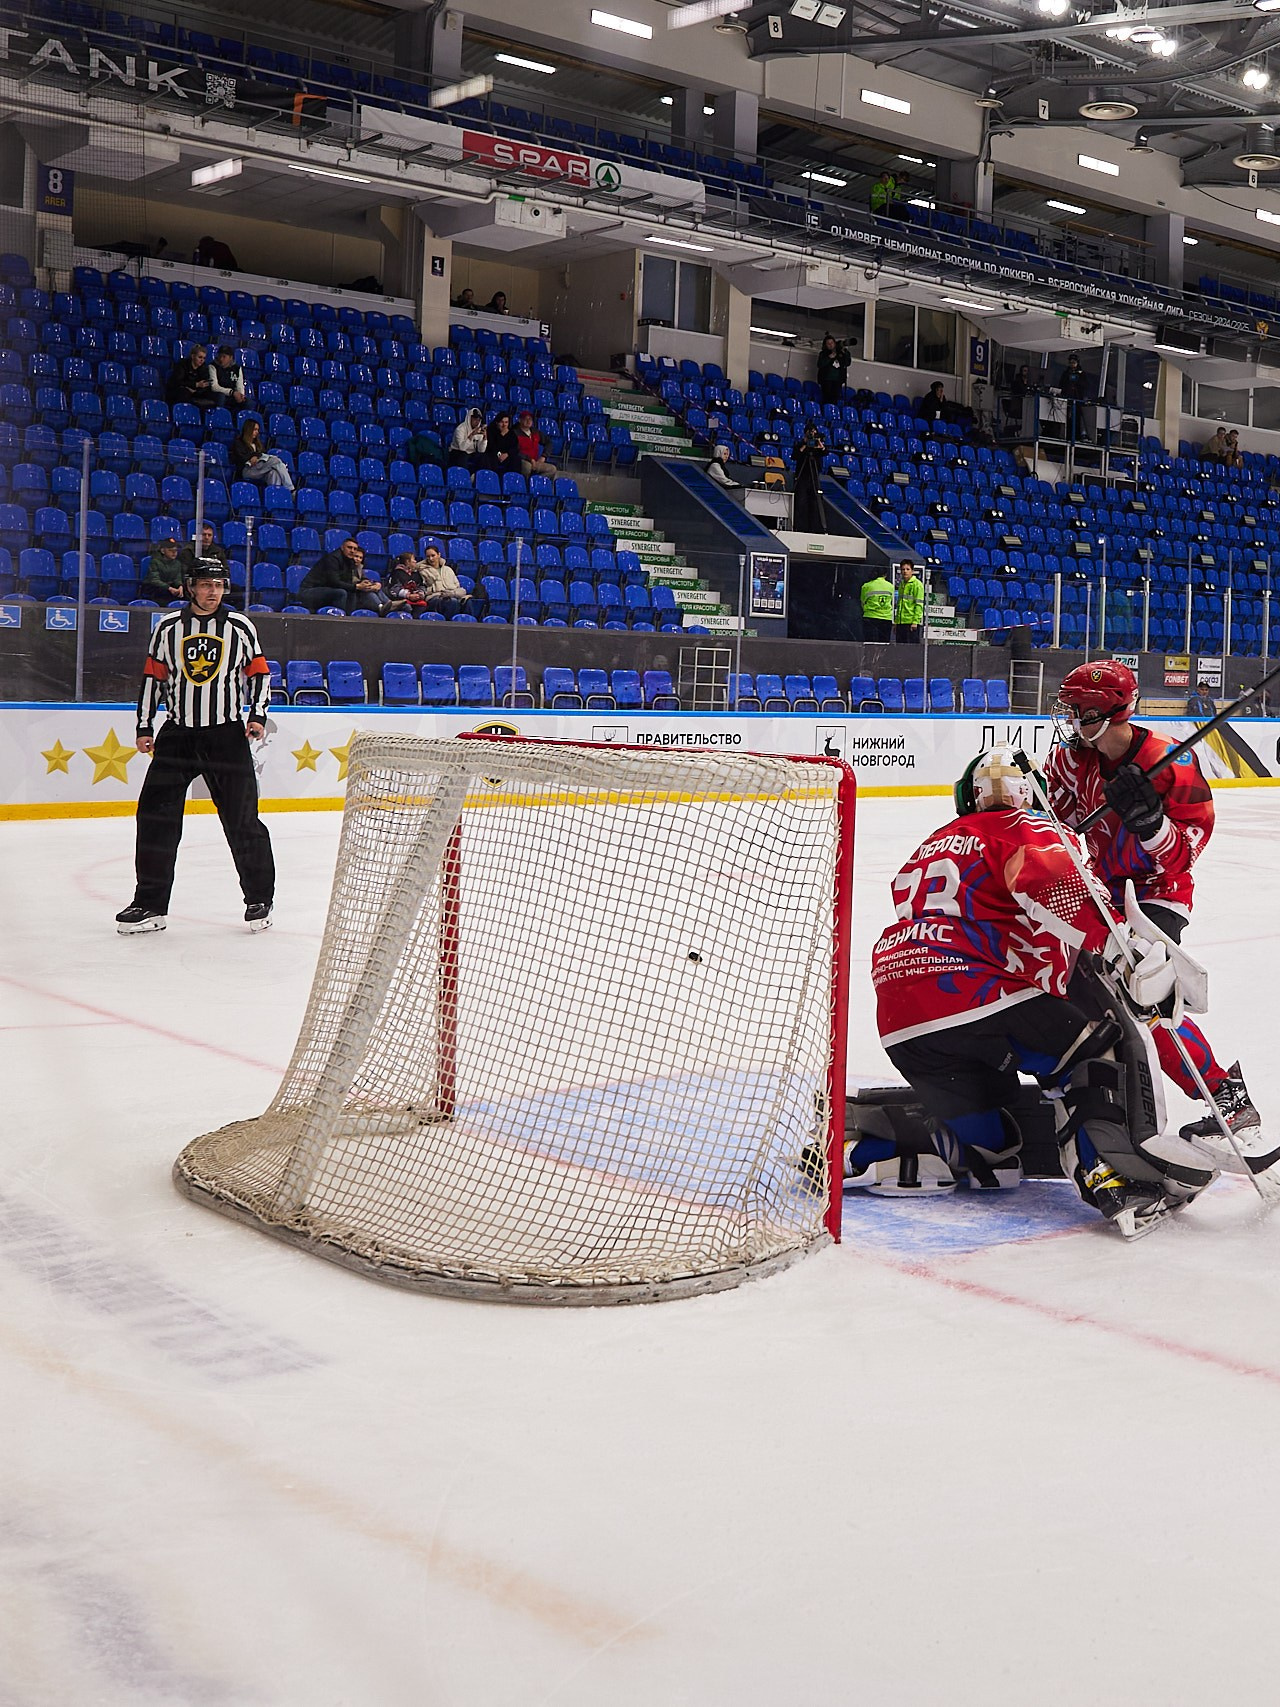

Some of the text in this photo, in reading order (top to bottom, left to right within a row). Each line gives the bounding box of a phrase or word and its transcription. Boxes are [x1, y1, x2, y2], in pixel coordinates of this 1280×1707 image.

[772, 21, 779, 33] 8
[0, 27, 189, 99] TANK
[1041, 104, 1047, 115] 7
[494, 143, 588, 178] SPAR
[49, 169, 62, 194] 8
[433, 259, 442, 271] 1
[884, 238, 943, 260] ЧЕМПИОНАТ
[944, 253, 981, 271] РОССИИ
[984, 262, 997, 275] ПО
[999, 265, 1034, 282] ХОККЕЮ
[1048, 277, 1117, 301] ВСЕРОССИЙСКАЯ
[541, 323, 549, 335] 5
[976, 344, 984, 362] 9
[617, 403, 645, 412] SYNERGETIC
[636, 425, 663, 435] SYNERGETIC
[654, 445, 681, 454] SYNERGETIC
[605, 506, 630, 514] ЧИСТОТЫ
[611, 518, 640, 527] SYNERGETIC
[631, 543, 661, 552] SYNERGETIC
[653, 567, 683, 576] SYNERGETIC
[677, 592, 707, 601] SYNERGETIC
[928, 607, 944, 615] ERGETIC
[700, 617, 730, 626] SYNERGETIC
[1164, 675, 1189, 684] FONBET
[637, 734, 742, 745] ПРАВИТЕЛЬСТВО
[853, 735, 905, 750] НИЖНИЙ
[853, 754, 915, 768] НОВГОРОД
[875, 923, 954, 954] ФЕНИКС
[905, 966, 926, 977] МЧС
[928, 965, 969, 973] РОССИИ
[1137, 1061, 1157, 1127] BAUER
